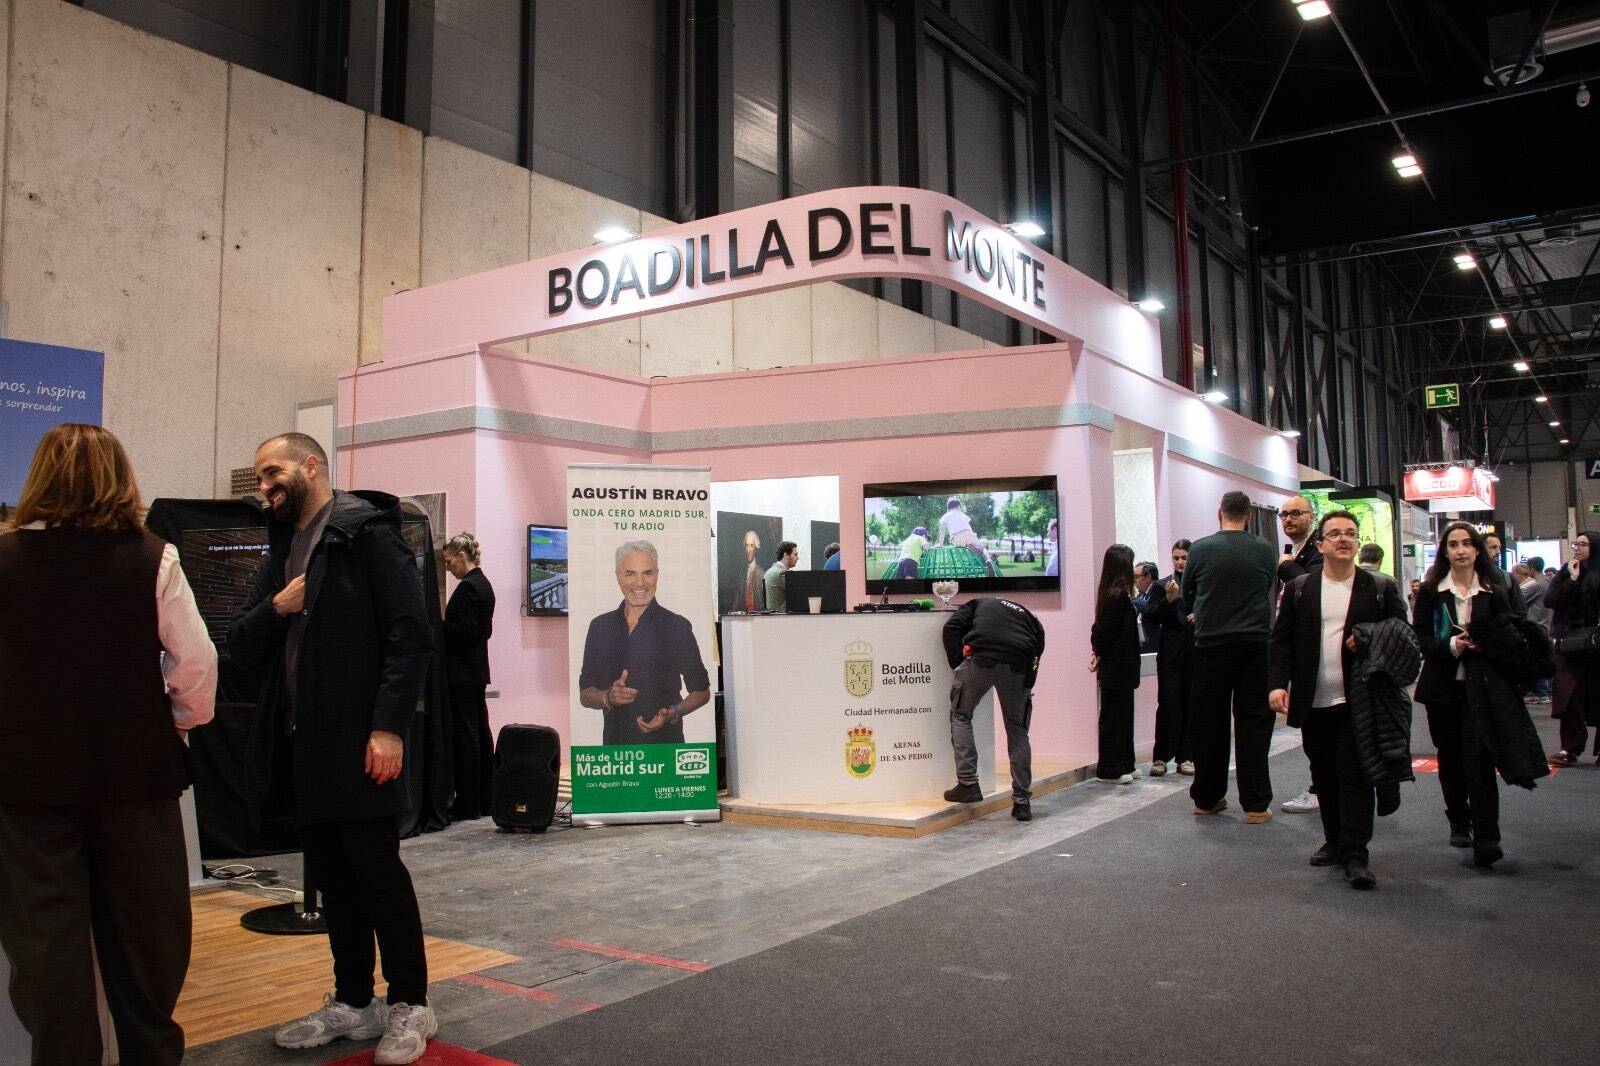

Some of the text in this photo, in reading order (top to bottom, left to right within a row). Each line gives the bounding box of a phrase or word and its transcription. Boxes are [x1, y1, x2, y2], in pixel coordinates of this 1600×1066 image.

[547, 202, 1047, 315] BOADILLA DEL MONTE
[37, 381, 86, 401] inspira
[6, 400, 63, 413] sorprender
[572, 486, 708, 501] AGUSTÍN BRAVO
[572, 508, 604, 517] ONDA
[608, 509, 635, 518] CERO
[639, 509, 681, 518] MADRID
[614, 522, 665, 531] TU RADIO
[881, 662, 931, 675] Boadilla
[882, 675, 931, 685] del Monte
[844, 706, 931, 716] Ciudad Hermanada con
[893, 741, 921, 749] ARENAS
[576, 750, 645, 762] Más de uno
[576, 761, 665, 776] Madrid sur
